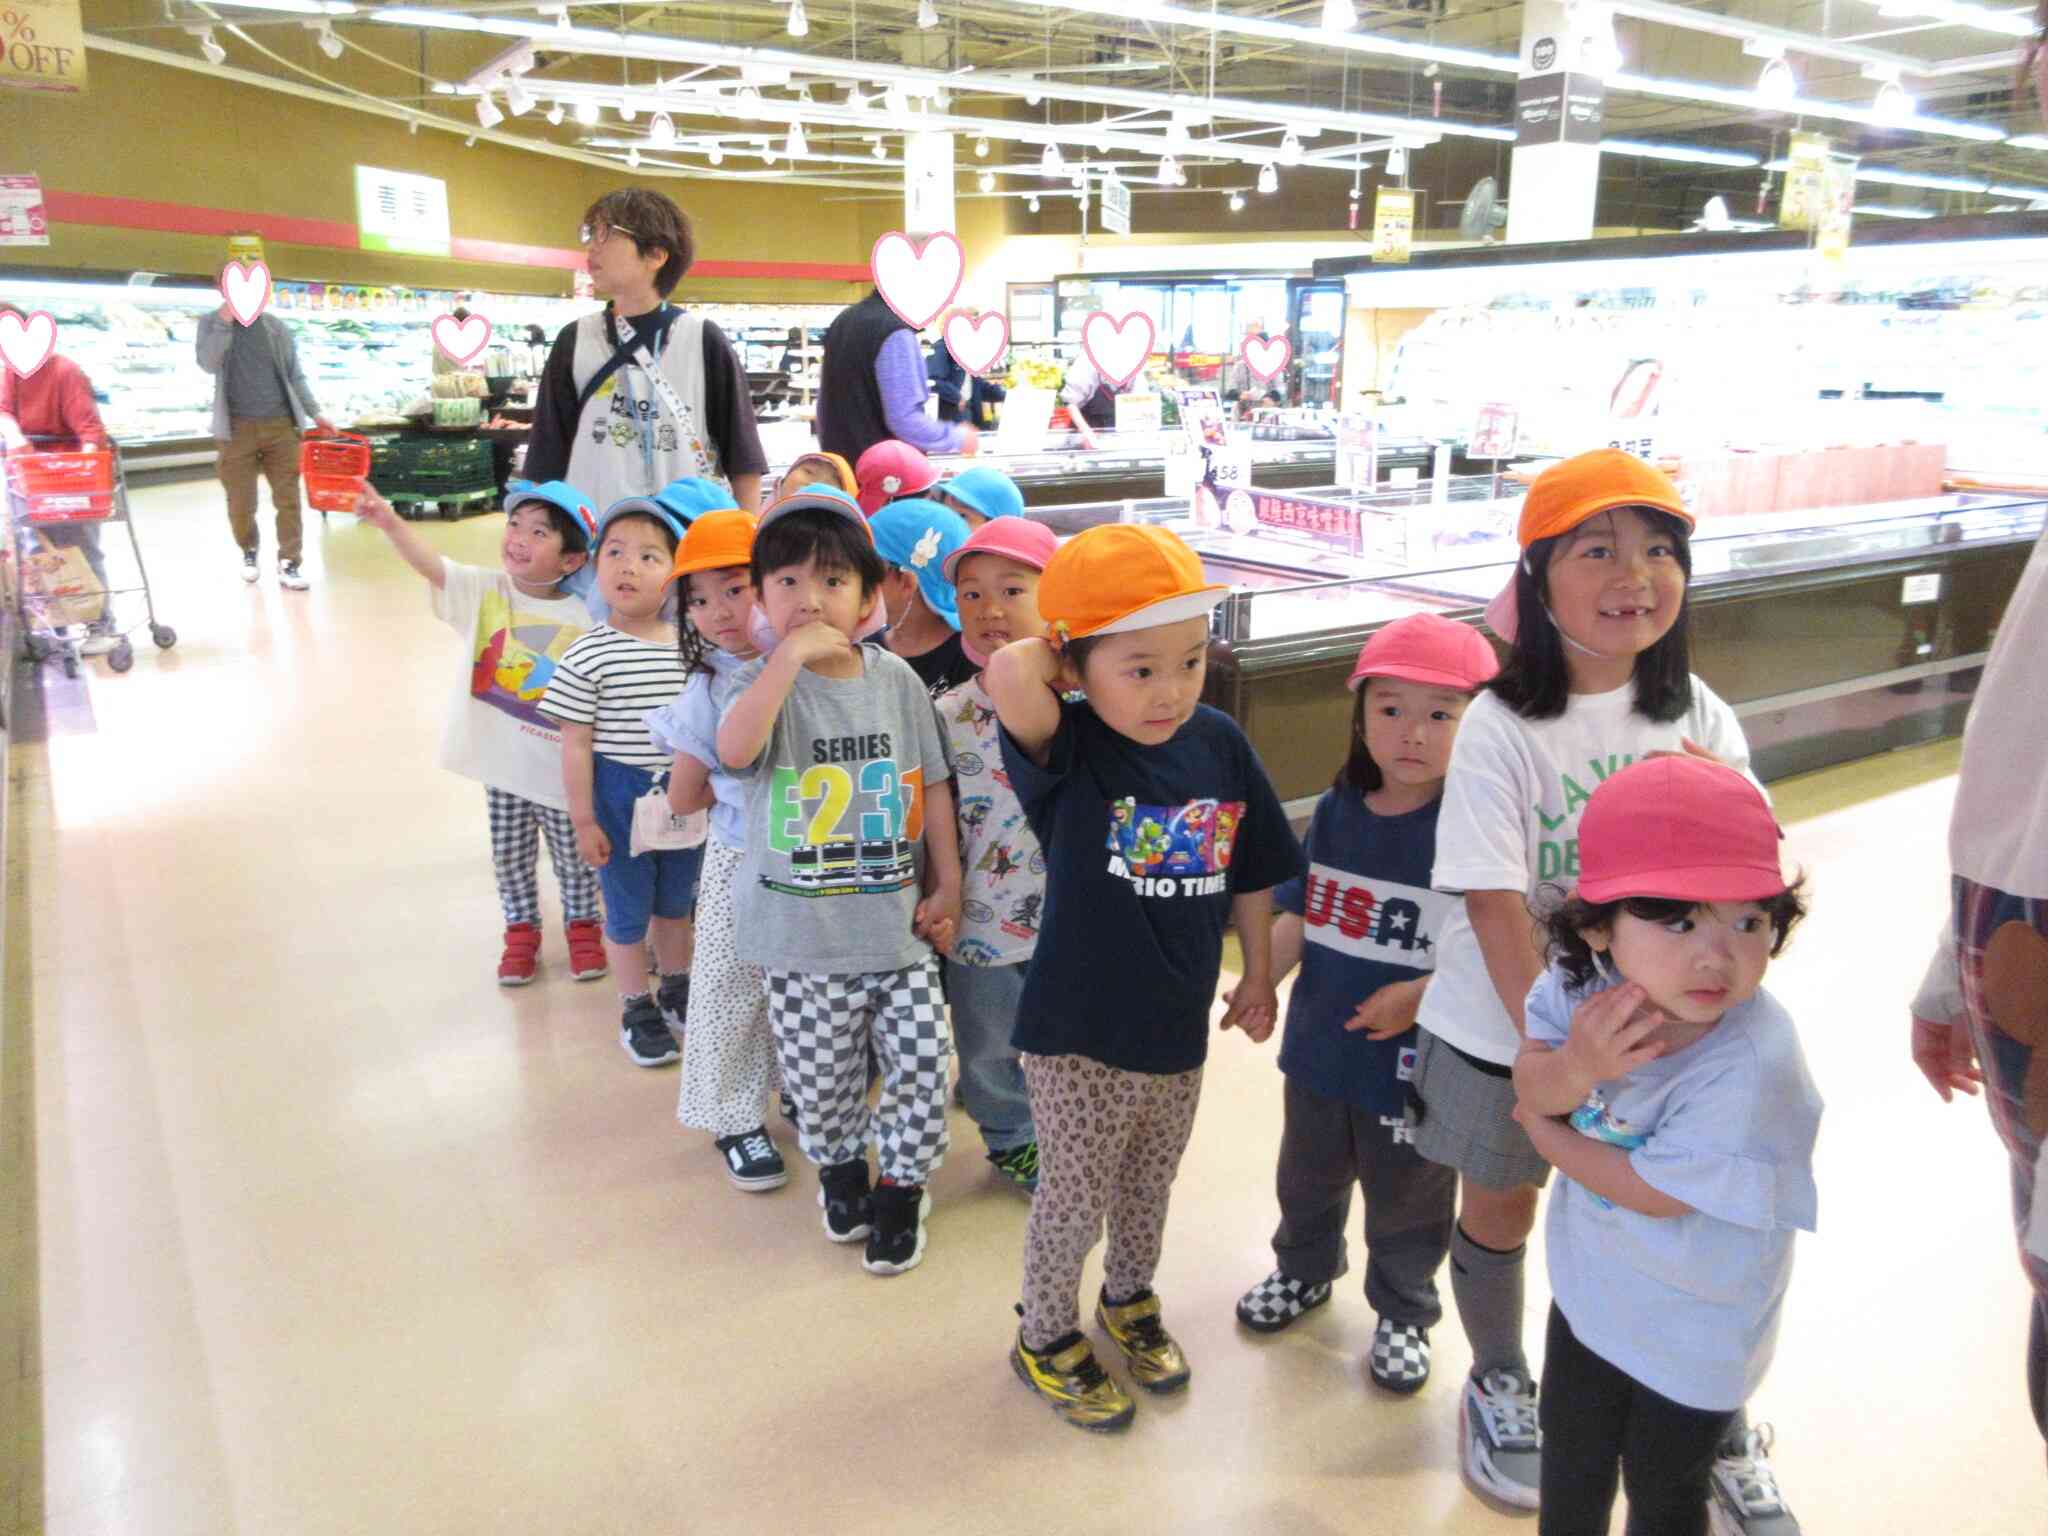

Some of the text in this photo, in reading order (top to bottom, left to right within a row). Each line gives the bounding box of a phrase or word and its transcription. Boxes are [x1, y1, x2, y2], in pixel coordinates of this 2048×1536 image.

[9, 42, 74, 76] OFF
[812, 733, 892, 764] SERIES
[1306, 873, 1421, 951] USA
